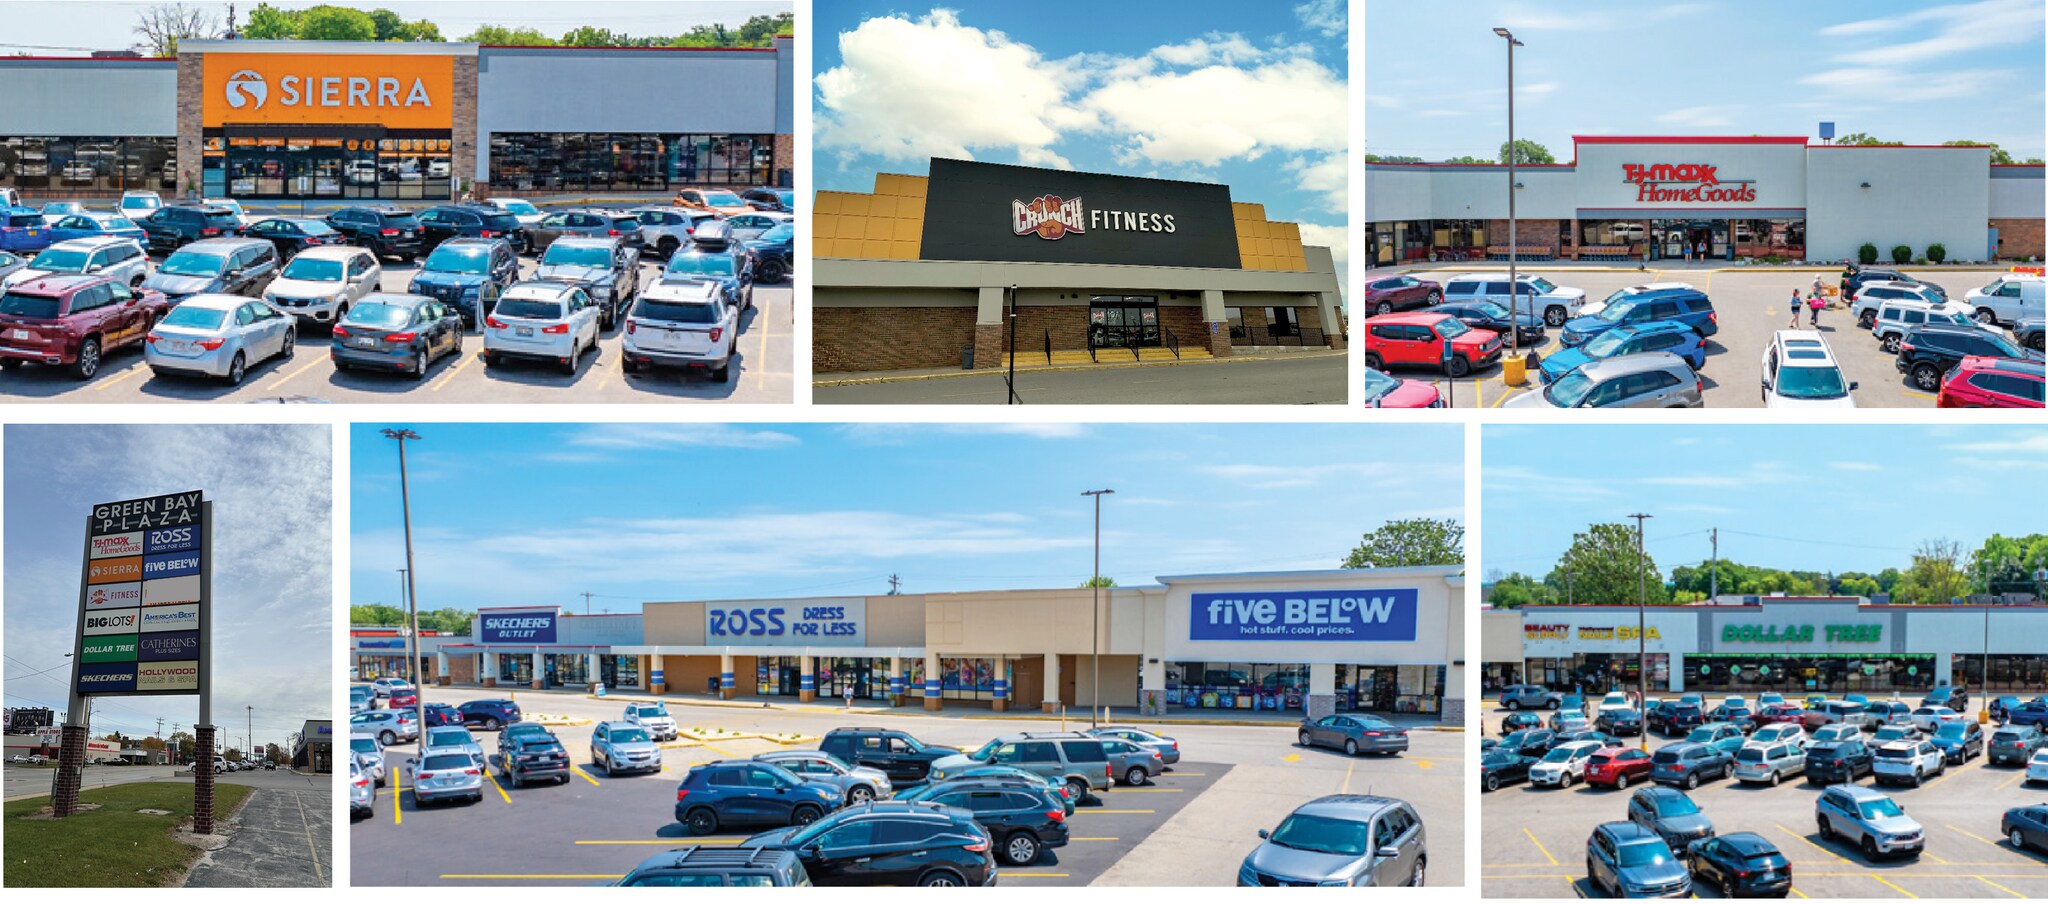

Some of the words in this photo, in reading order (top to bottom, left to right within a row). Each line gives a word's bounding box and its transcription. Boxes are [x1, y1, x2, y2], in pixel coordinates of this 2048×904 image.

[280, 75, 432, 107] SIERRA
[1636, 183, 1757, 202] HomeGoods
[1014, 199, 1085, 233] CRUNCH
[1091, 209, 1176, 233] FITNESS
[95, 500, 156, 519] GREEN
[165, 494, 199, 510] BAY
[151, 528, 191, 544] ROSS
[101, 543, 140, 554] HomeGoods
[103, 565, 139, 576] SIERRA
[145, 561, 166, 572] five
[168, 558, 199, 570] BELOW
[110, 591, 139, 599] FITNESS
[803, 607, 845, 620] DRESS
[1207, 599, 1277, 625] five
[1284, 596, 1395, 624] BELOW
[485, 617, 551, 629] SKECHERS
[710, 608, 785, 636] ROSS
[1524, 624, 1570, 632] BEAUTY
[498, 630, 536, 638] OUTLET
[793, 623, 818, 635] FOR
[823, 622, 856, 635] LESS
[1240, 626, 1258, 634] hot
[1260, 625, 1289, 634] stuff.
[1291, 625, 1314, 634] cool
[1316, 625, 1355, 636] prices.
[1722, 624, 1815, 643] DOLLAR
[1824, 624, 1883, 643] TREE
[84, 645, 113, 653] DOLLAR
[116, 644, 135, 652] TREE
[141, 637, 197, 649] CATHERINES
[139, 667, 196, 676] HOLLYWOOD
[80, 674, 133, 683] SKECHERS
